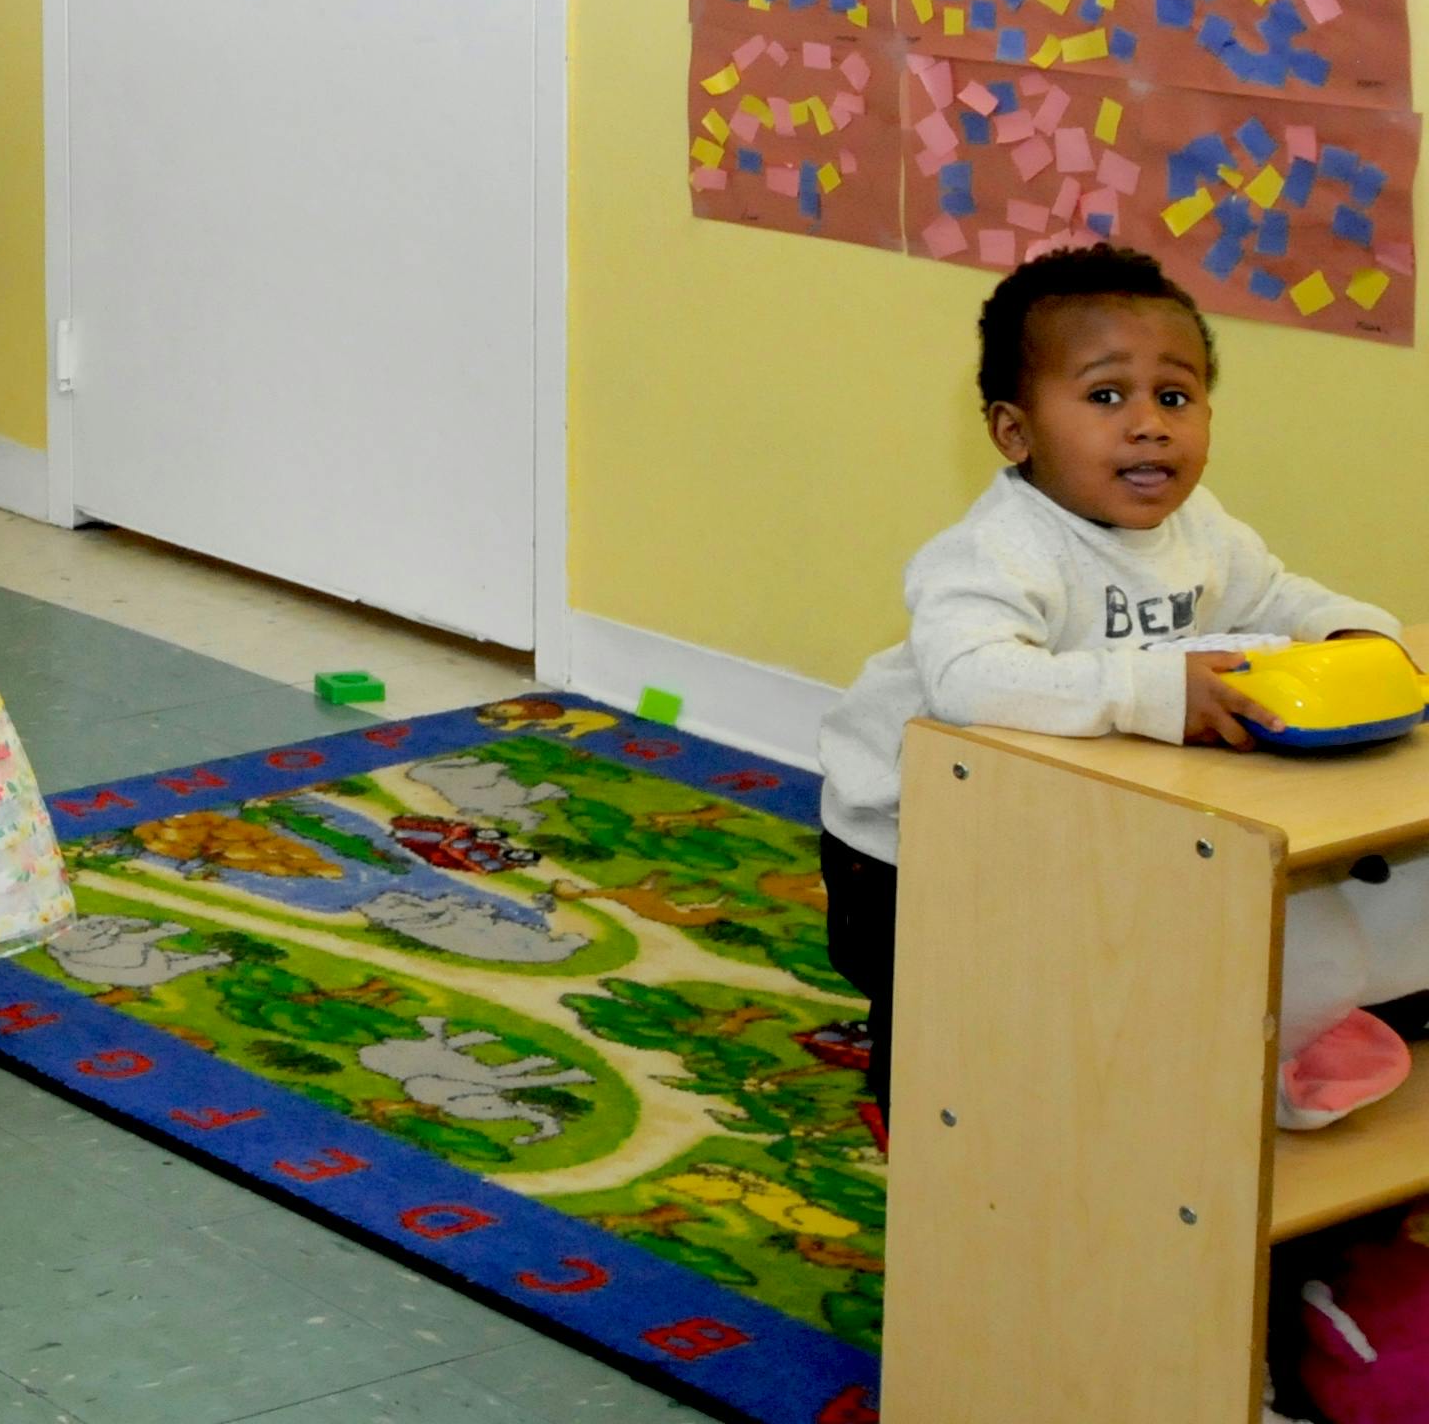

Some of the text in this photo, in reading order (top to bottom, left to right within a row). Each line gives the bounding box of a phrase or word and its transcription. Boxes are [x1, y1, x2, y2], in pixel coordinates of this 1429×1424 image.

[272, 1146, 373, 1183] E
[516, 1256, 611, 1294] C
[641, 1316, 752, 1362] B
